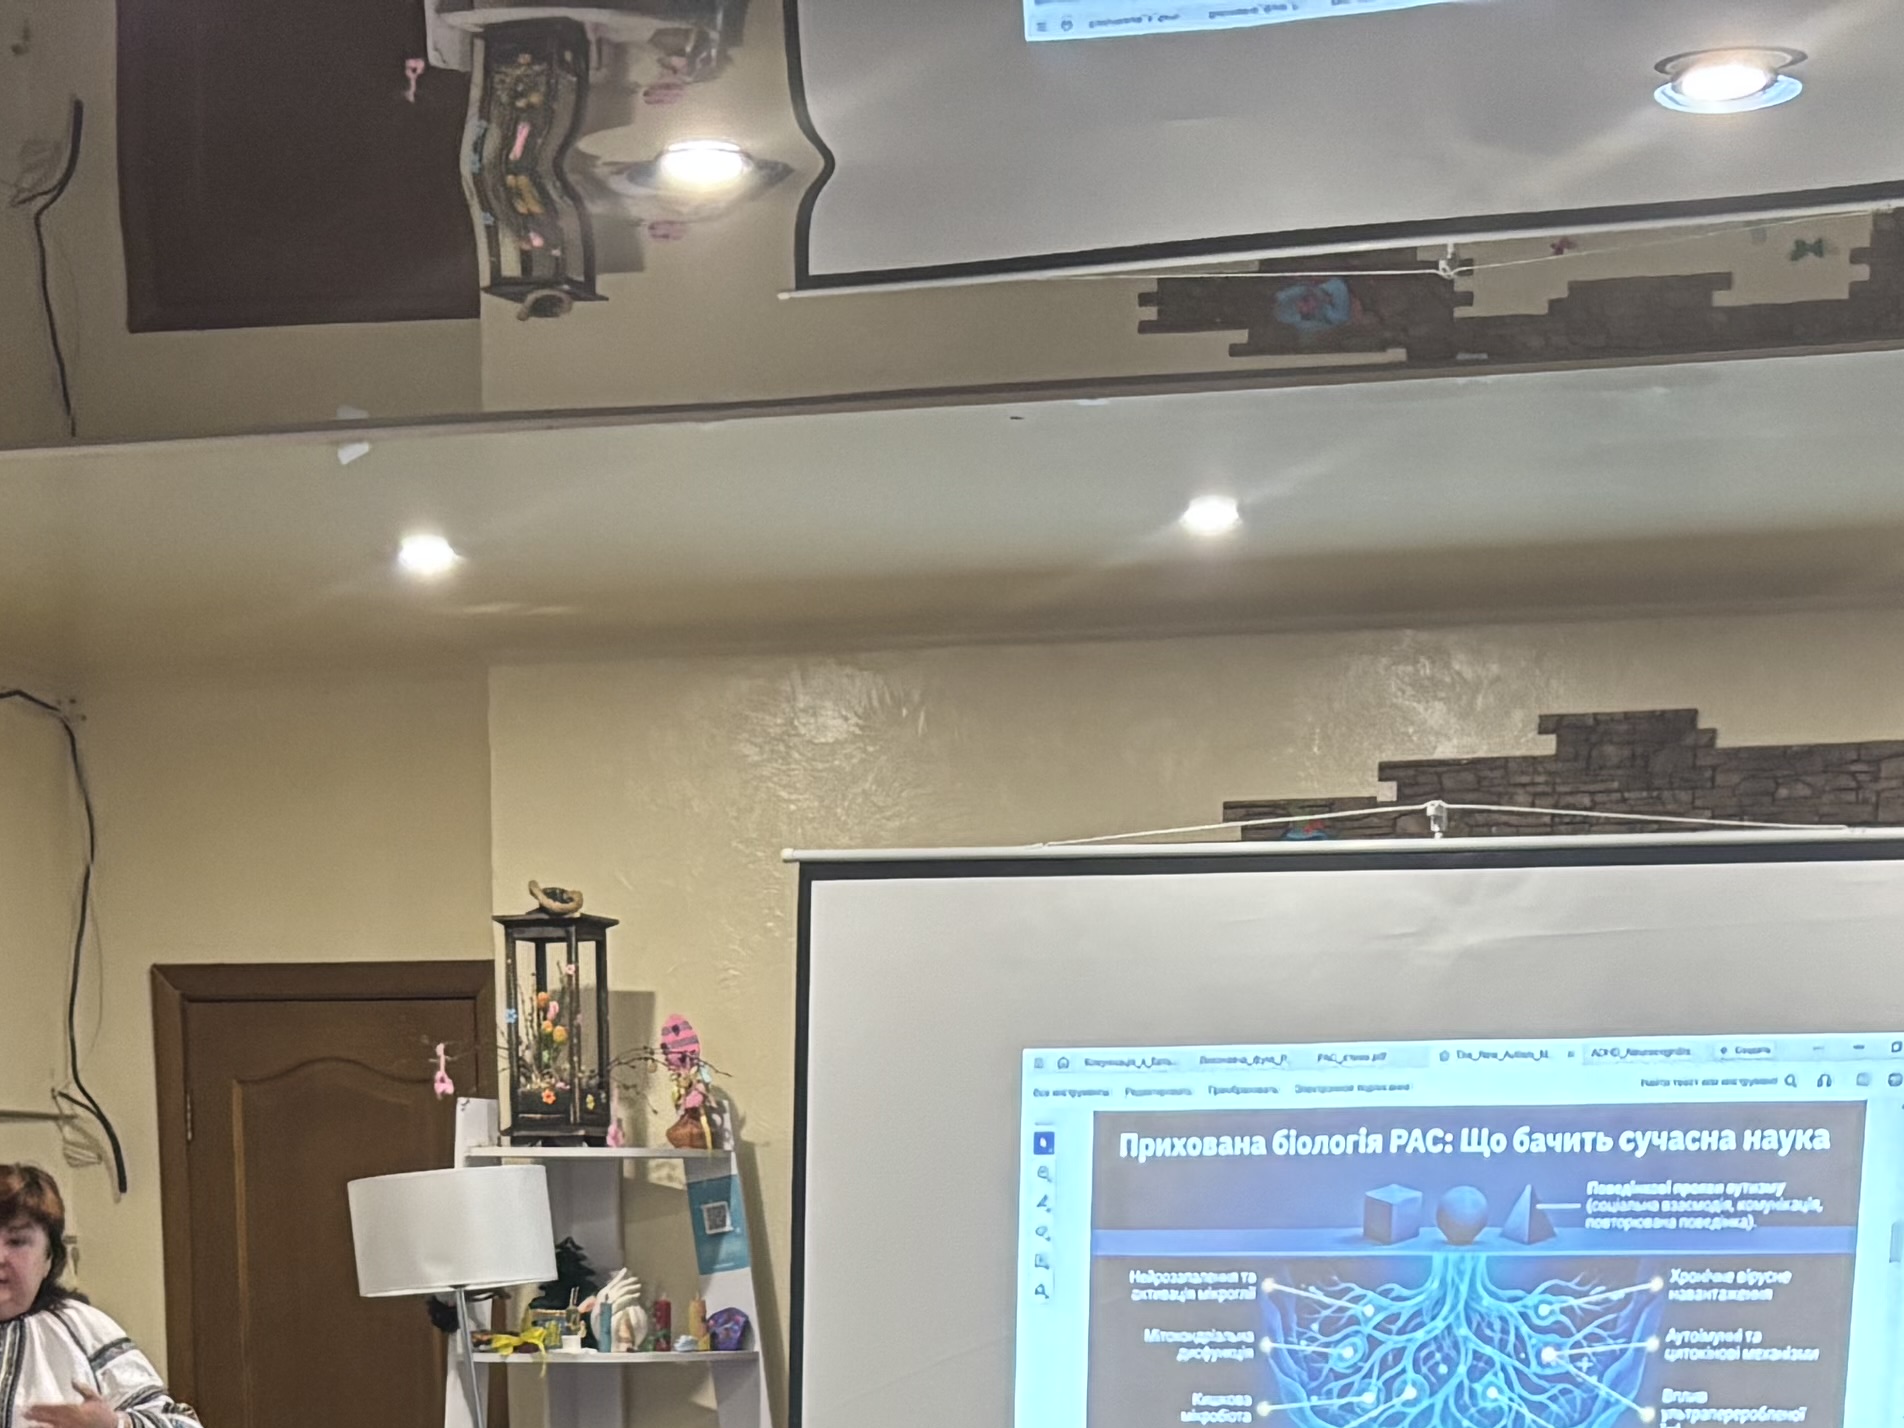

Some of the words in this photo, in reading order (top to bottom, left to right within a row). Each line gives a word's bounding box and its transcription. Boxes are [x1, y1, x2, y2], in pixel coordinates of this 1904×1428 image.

[1118, 1132, 1267, 1163] Прихована
[1271, 1125, 1383, 1157] біологія
[1460, 1126, 1507, 1160] Що
[1512, 1125, 1614, 1155] бачить
[1618, 1130, 1737, 1158] сучасна
[1742, 1127, 1831, 1156] наука
